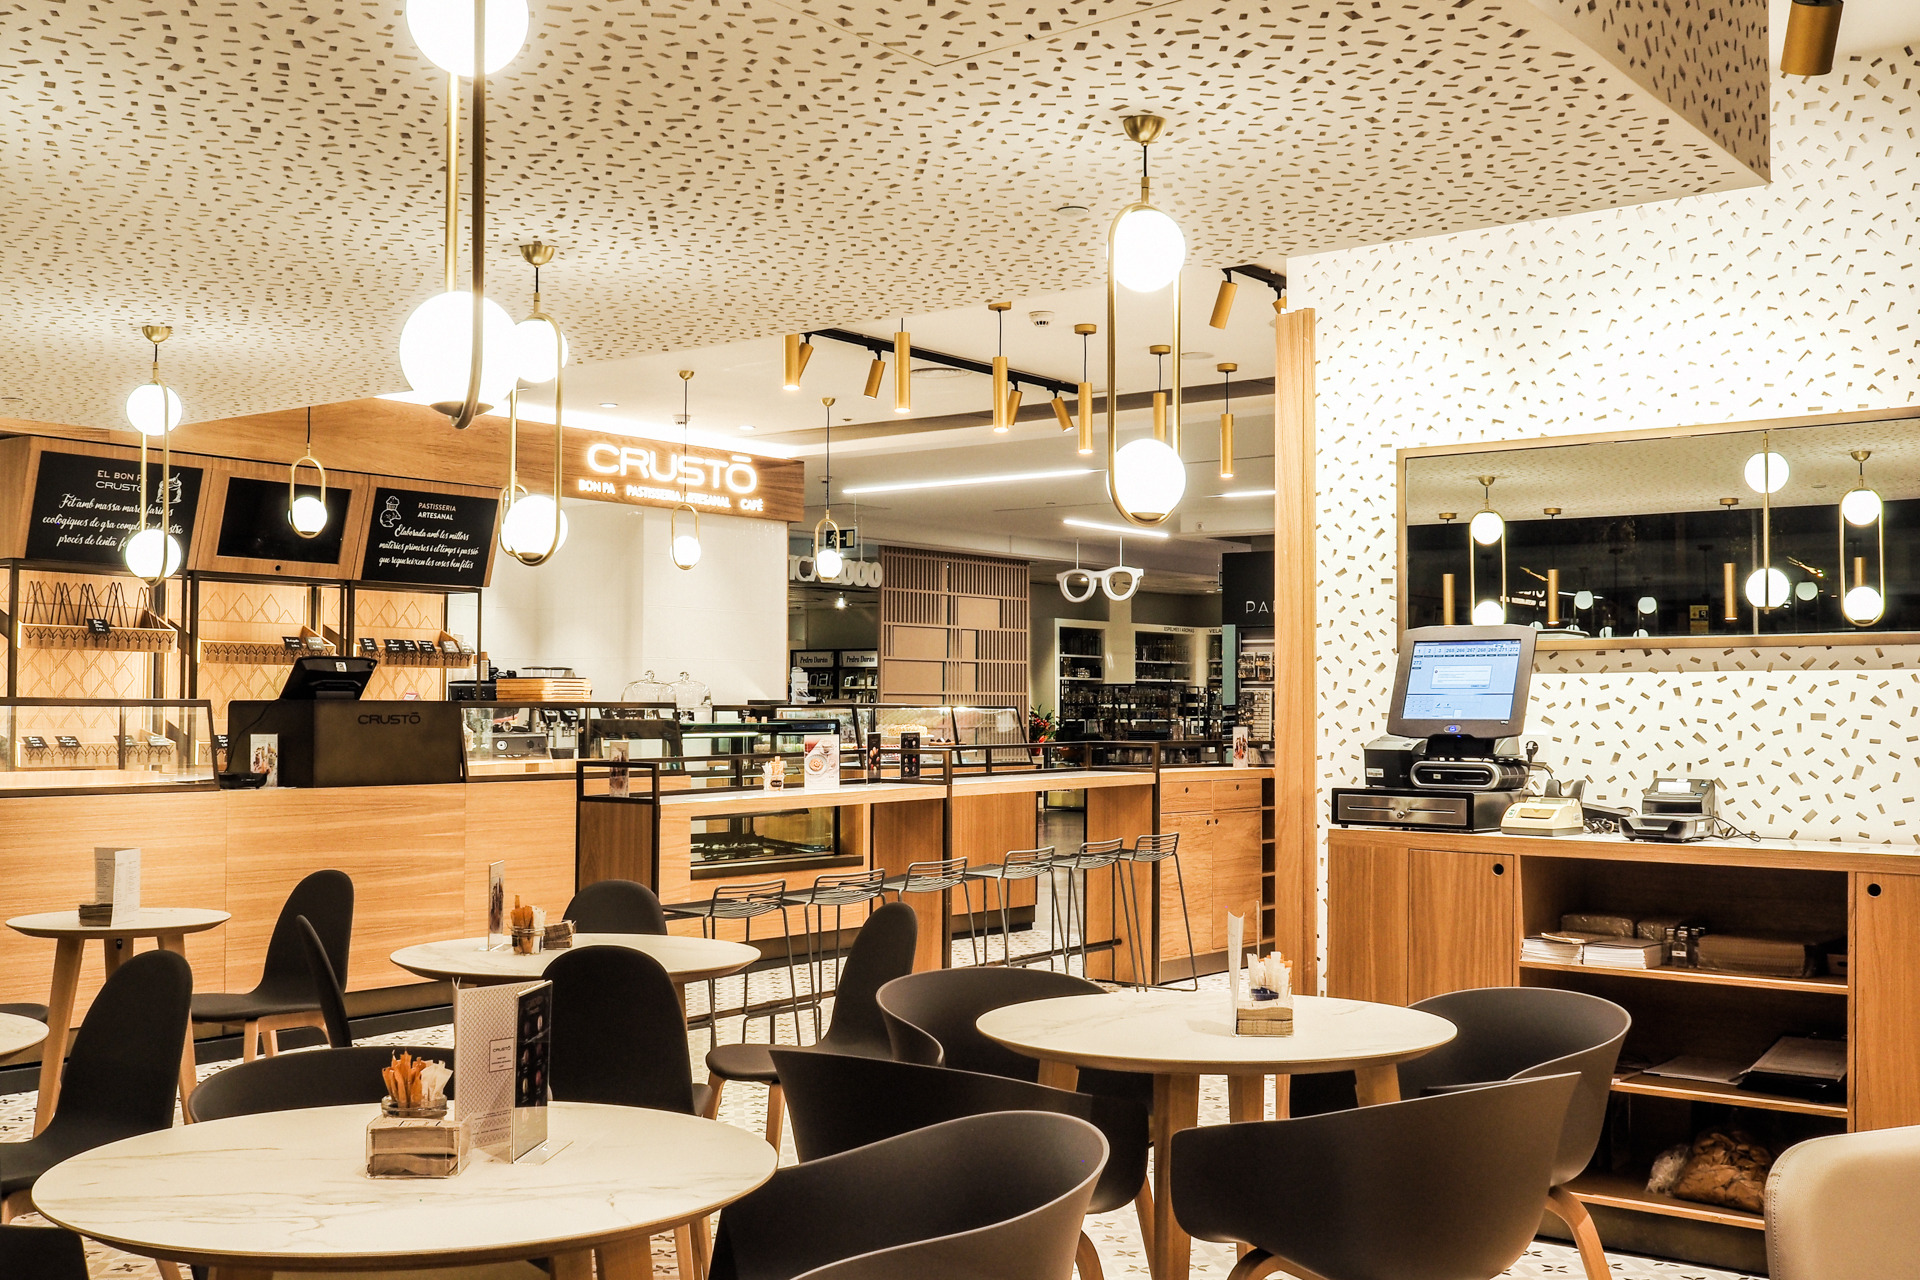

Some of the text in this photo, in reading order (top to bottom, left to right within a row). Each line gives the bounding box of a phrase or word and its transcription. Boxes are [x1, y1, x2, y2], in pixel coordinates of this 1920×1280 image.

[97, 470, 111, 478] EL
[114, 472, 135, 480] BON
[578, 479, 601, 492] BON
[602, 482, 616, 494] PA
[740, 498, 764, 512] CAFÉ
[76, 498, 94, 509] amb
[145, 504, 174, 519] farins
[418, 502, 457, 512] PASTISSERIA
[417, 511, 454, 520] ARTESANAL
[89, 517, 99, 528] de
[100, 520, 115, 532] gra
[394, 524, 469, 541] Elaborada amb les millors
[56, 534, 84, 547] procés
[84, 535, 95, 546] de
[95, 535, 117, 547] lenta
[379, 557, 390, 566] que
[425, 557, 435, 566] les
[1245, 600, 1274, 614] PA
[800, 656, 813, 664] Pedro
[846, 655, 860, 663] Pedro
[358, 712, 421, 725] CRUSTŌ
